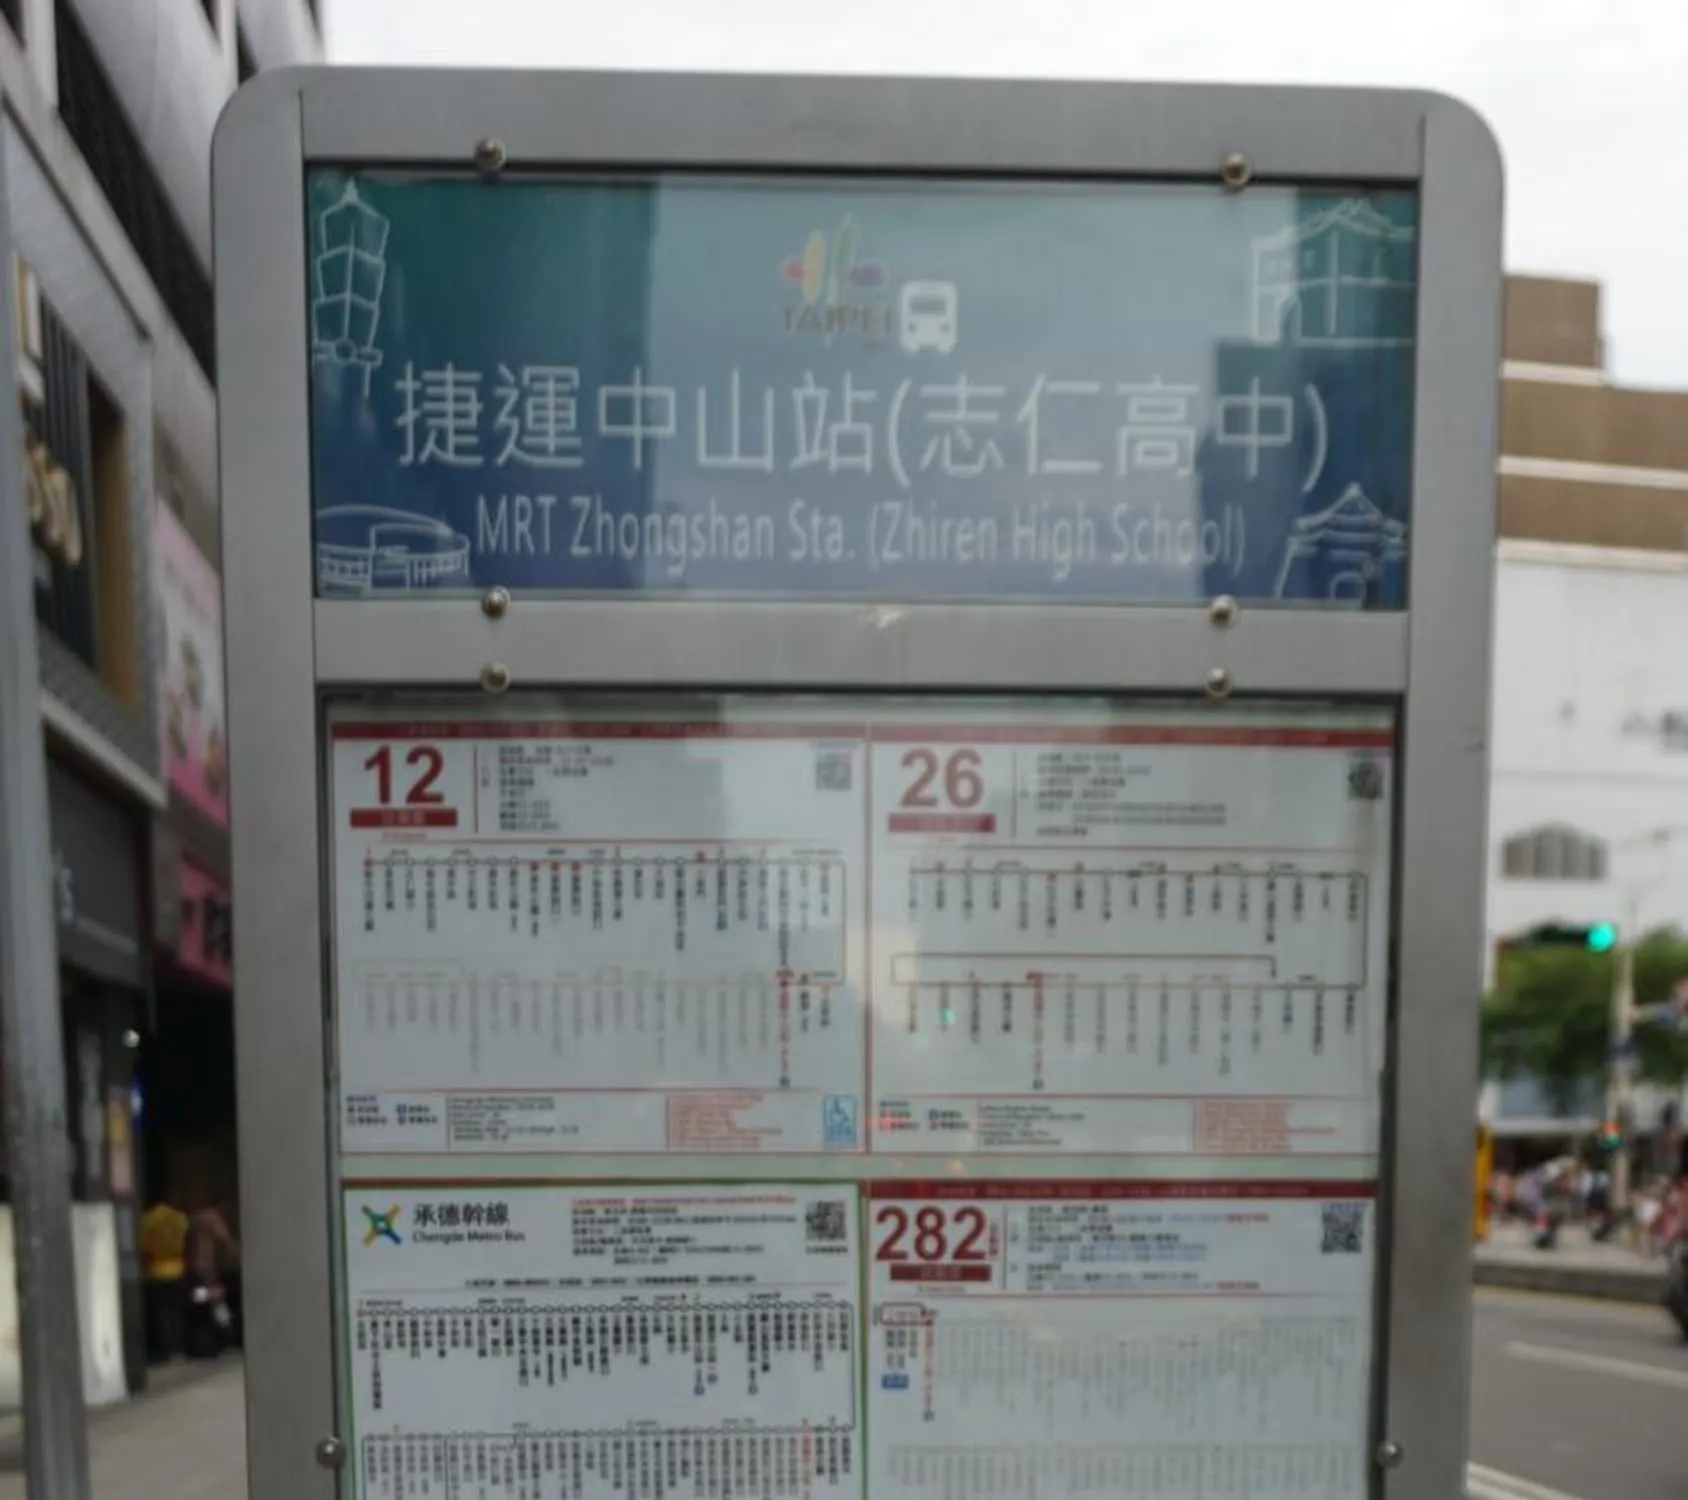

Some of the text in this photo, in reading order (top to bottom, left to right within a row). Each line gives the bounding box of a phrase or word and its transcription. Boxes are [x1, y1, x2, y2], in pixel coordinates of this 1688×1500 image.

[394, 358, 1328, 488] 捷運中山站(志仁高中)
[476, 494, 1246, 578] MRT Zhongshan Sta. (Zhiren High School)
[364, 744, 446, 805] 12
[899, 748, 984, 808] 26
[875, 1205, 987, 1262] 282
